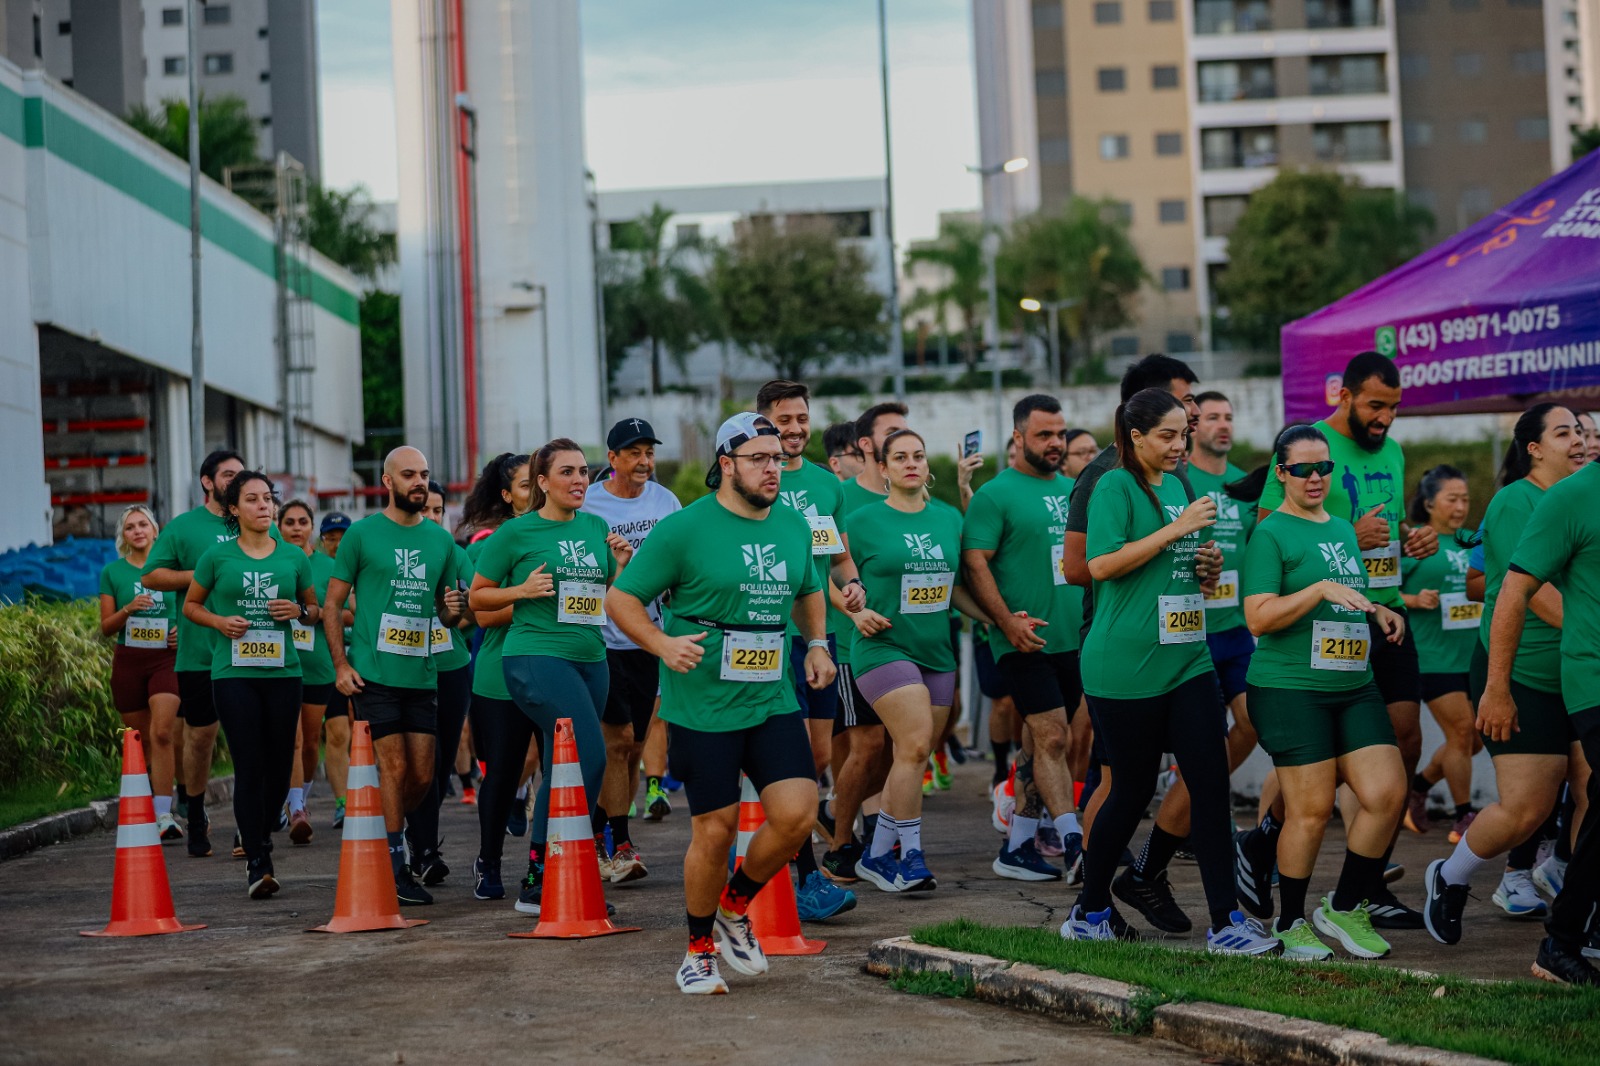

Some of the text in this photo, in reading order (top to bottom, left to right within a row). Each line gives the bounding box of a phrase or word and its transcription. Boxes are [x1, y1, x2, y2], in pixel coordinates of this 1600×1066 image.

[1399, 304, 1560, 355] (43) 99971-0075
[556, 566, 602, 575] BOULEVARD
[1363, 557, 1394, 573] 2758
[740, 583, 790, 592] BOULEVARD
[911, 586, 943, 601] 2332
[568, 596, 597, 611] 2500
[756, 613, 781, 622] SICOOB
[1170, 610, 1199, 629] 2045
[133, 628, 161, 639] 2865
[389, 629, 421, 644] 2943
[242, 642, 275, 655] 2084
[1325, 639, 1362, 655] 2112
[736, 649, 776, 667] 2297
